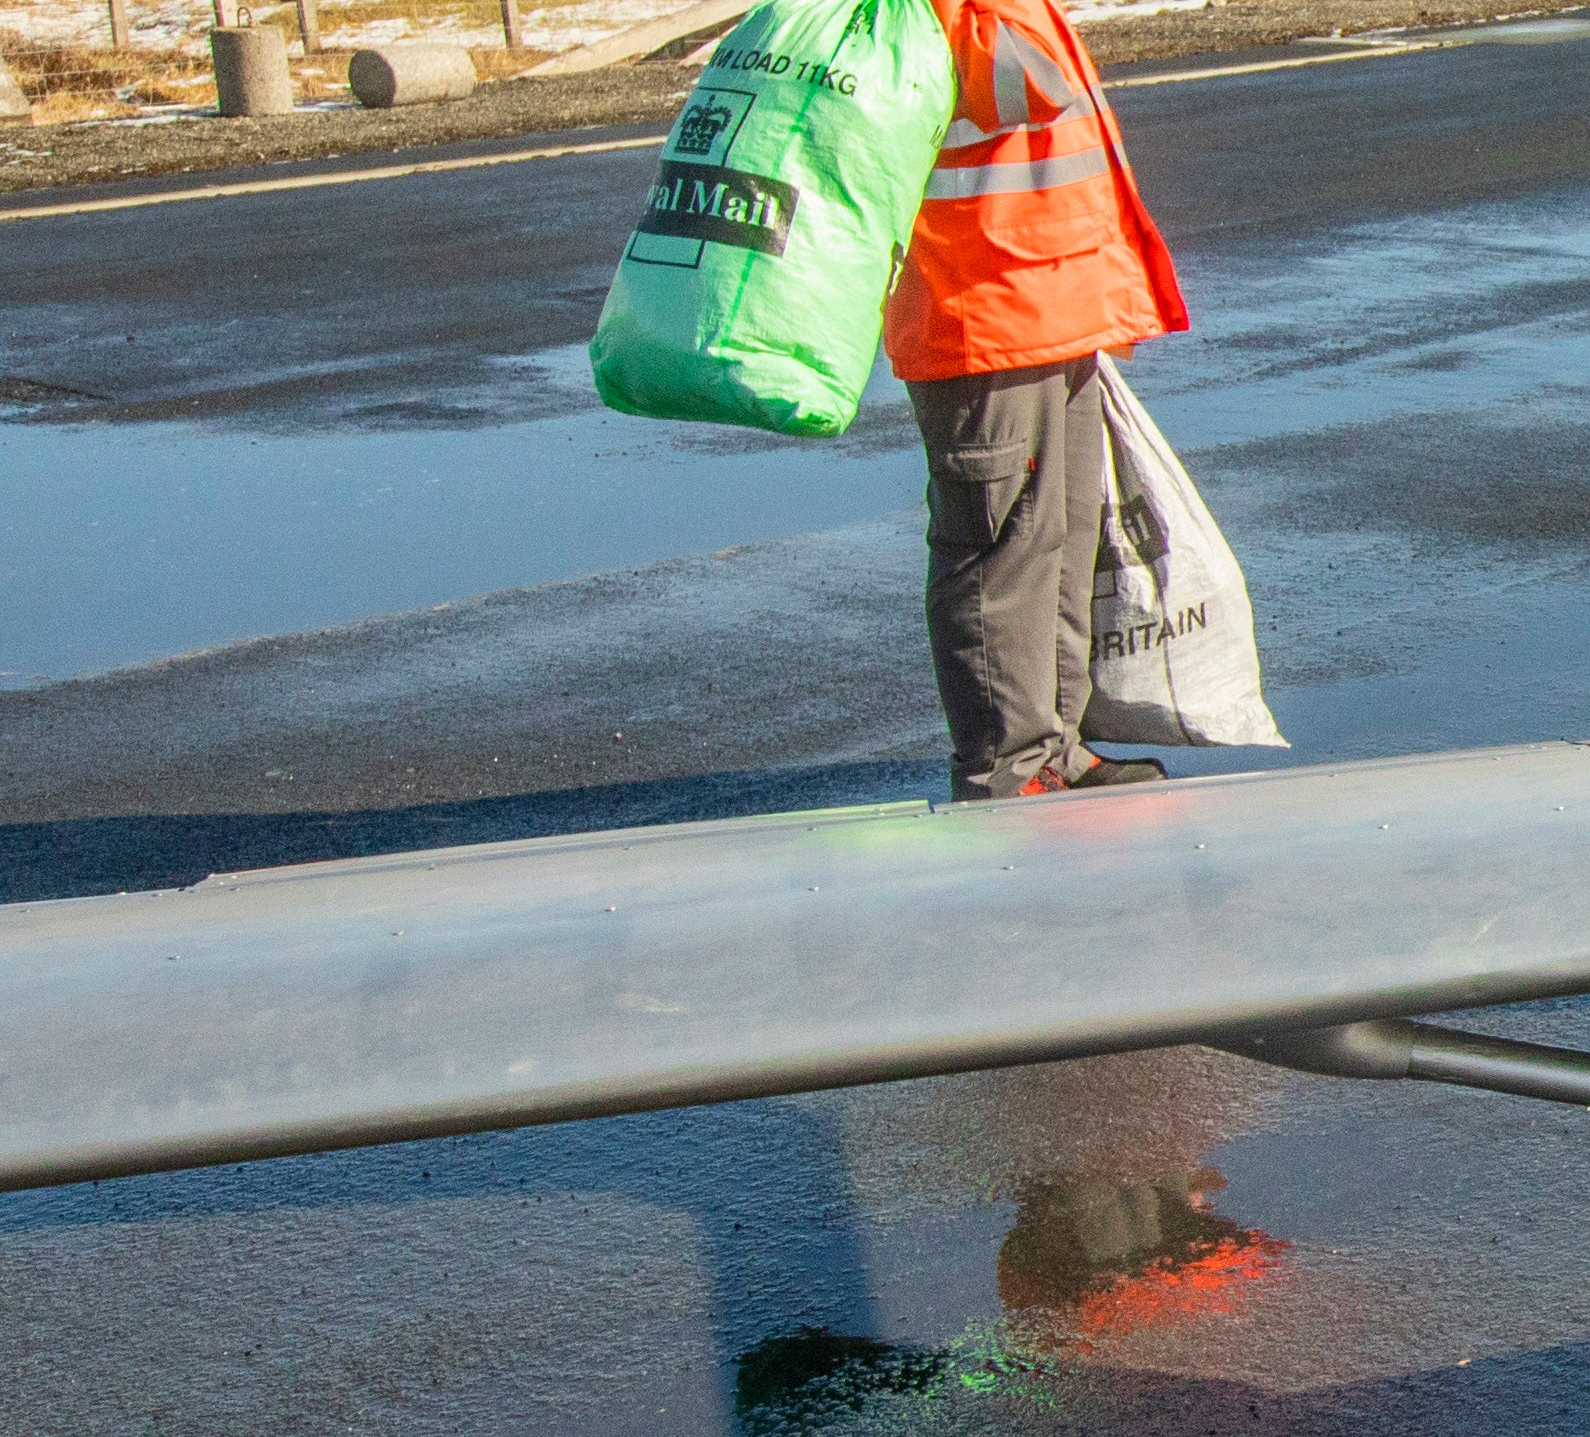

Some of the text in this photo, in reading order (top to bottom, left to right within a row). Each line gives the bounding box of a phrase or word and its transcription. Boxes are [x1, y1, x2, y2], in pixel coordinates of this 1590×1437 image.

[731, 49, 791, 75] LOAD
[799, 61, 860, 97] 11KG
[684, 179, 780, 230] Mail
